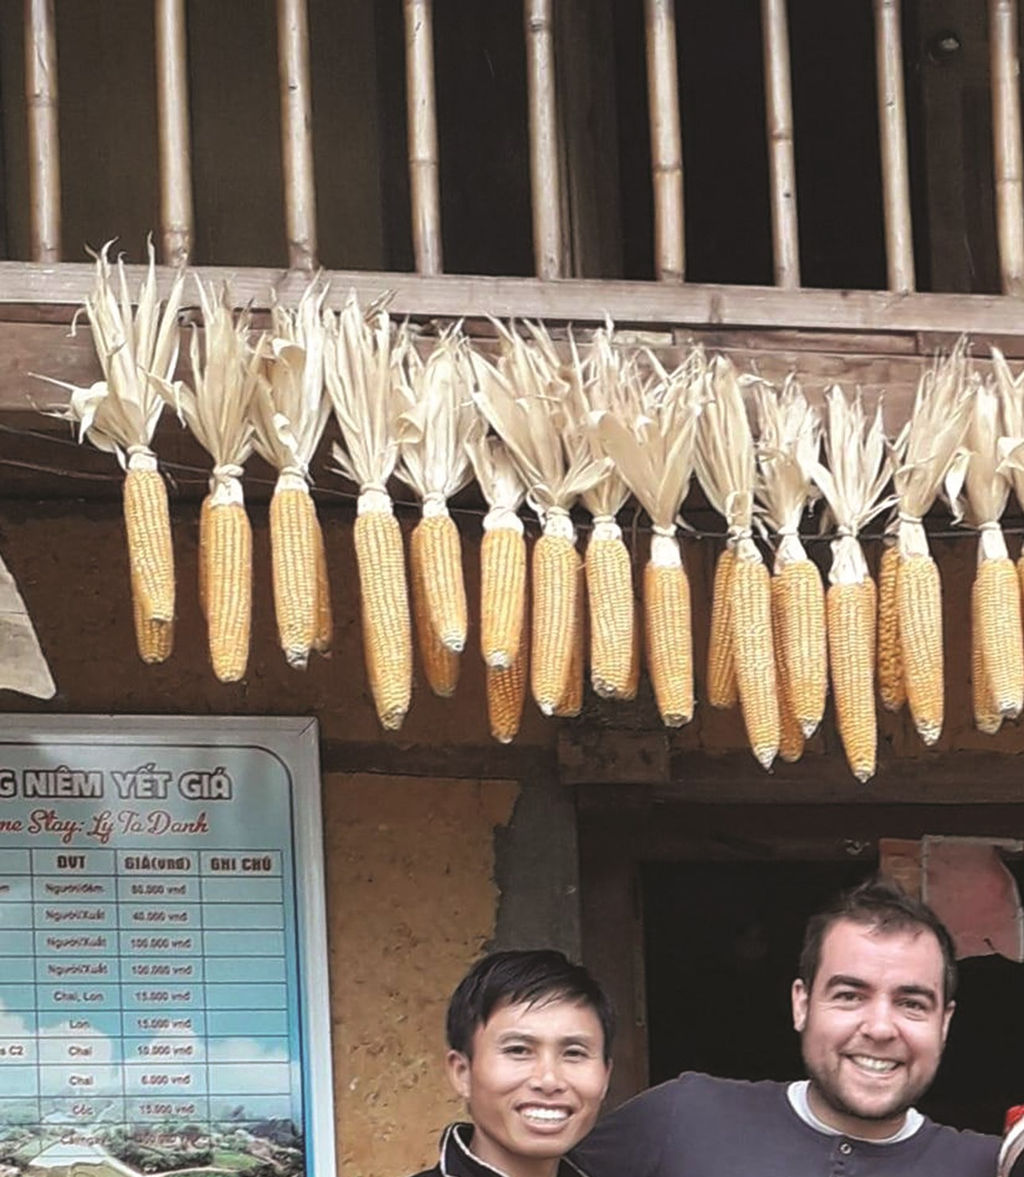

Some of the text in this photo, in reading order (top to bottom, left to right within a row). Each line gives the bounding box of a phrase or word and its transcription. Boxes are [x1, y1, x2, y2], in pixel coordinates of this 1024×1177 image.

[23, 765, 104, 798] NIÊM
[110, 762, 173, 799] YẾT
[178, 766, 232, 800] GIÁ
[28, 809, 84, 844] Stay:
[147, 810, 209, 835] Danh
[210, 855, 272, 871] GHI CHÚ
